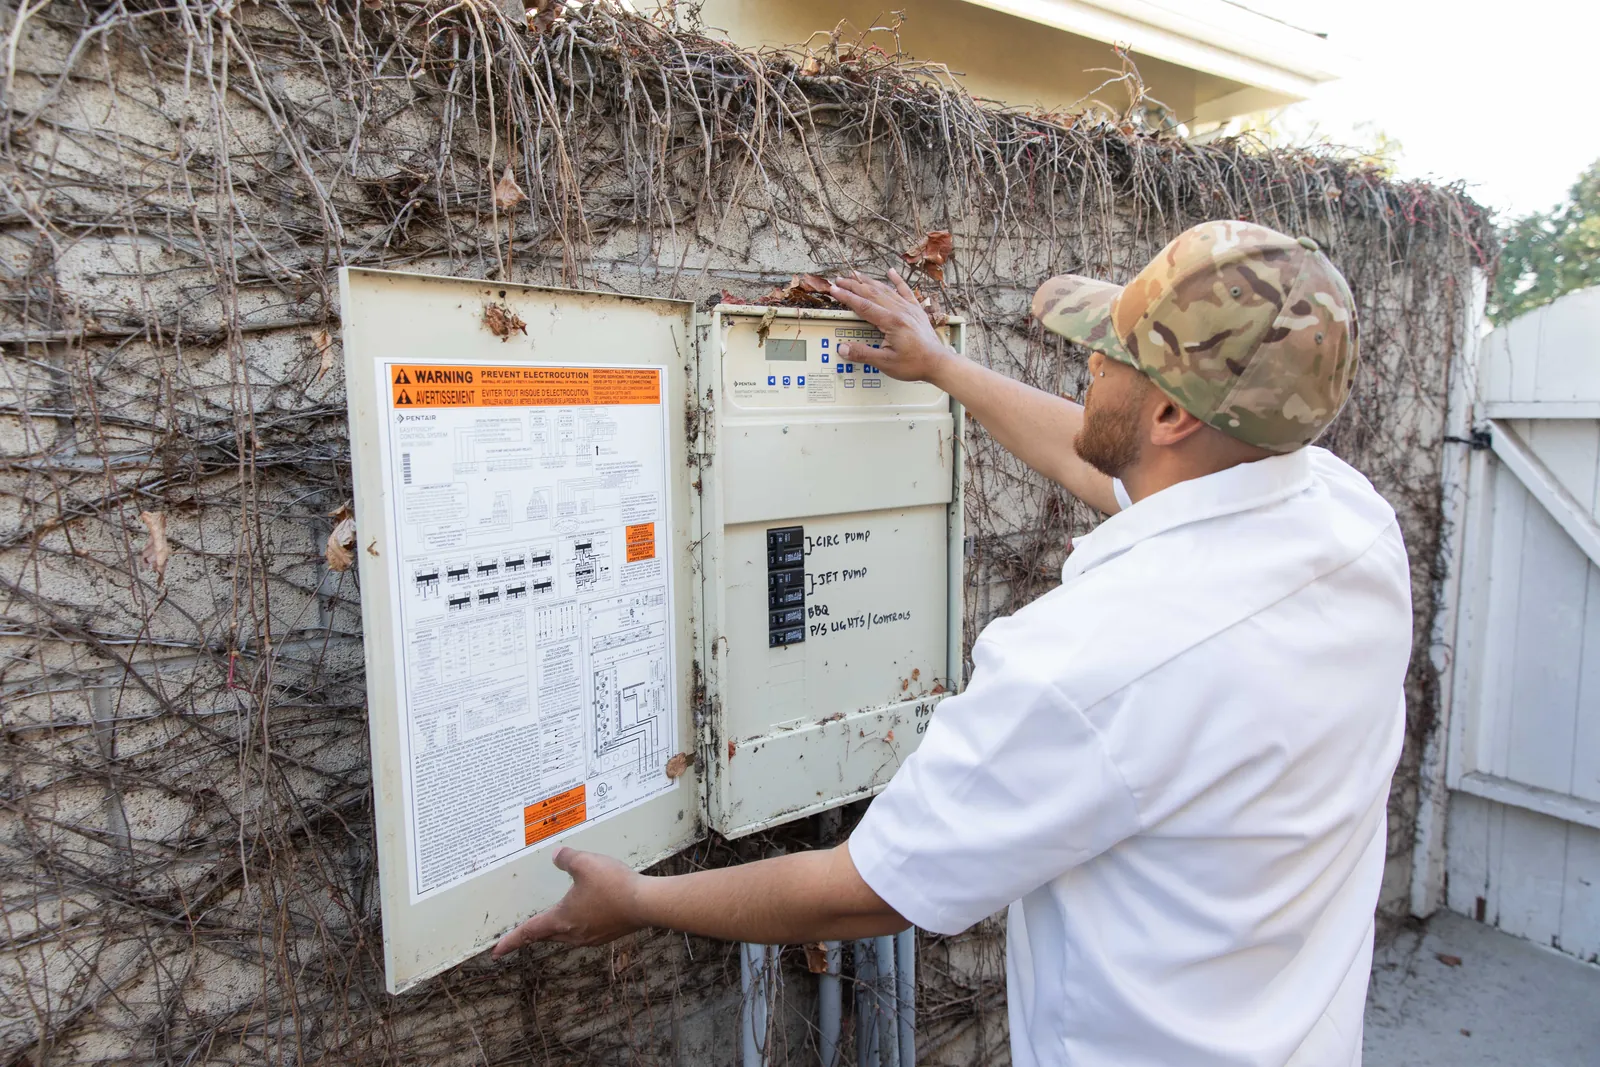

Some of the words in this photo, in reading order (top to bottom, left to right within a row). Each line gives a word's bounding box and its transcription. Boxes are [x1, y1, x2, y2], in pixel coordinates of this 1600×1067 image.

[415, 370, 473, 384] WARNING
[416, 390, 474, 404] AVERTISSEMENT
[504, 389, 518, 397] TOUT
[520, 389, 540, 397] RISQUE
[816, 534, 840, 547] CIRC
[845, 530, 870, 544] PUMP
[818, 571, 838, 586] JET
[843, 567, 867, 581] PUMP
[808, 604, 830, 619] BBQ
[810, 623, 827, 636] P/S
[549, 792, 570, 804] WARNING
